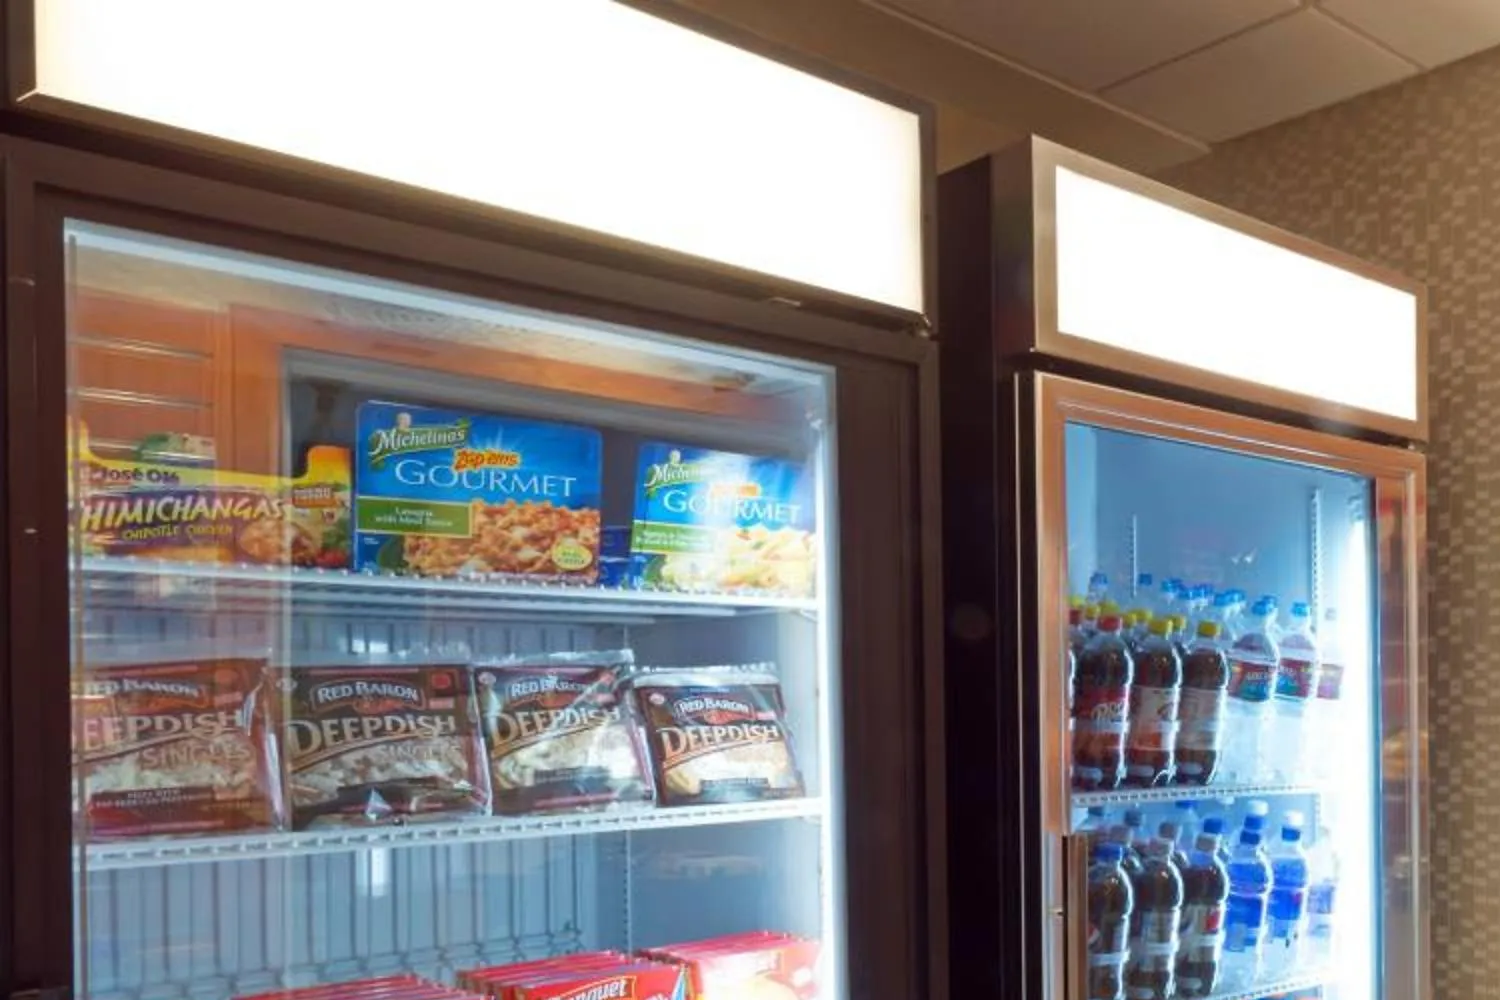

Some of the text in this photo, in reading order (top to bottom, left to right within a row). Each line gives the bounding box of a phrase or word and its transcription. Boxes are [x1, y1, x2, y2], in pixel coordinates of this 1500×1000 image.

[395, 458, 577, 497] GOURMET
[79, 494, 285, 530] HIMICHANGAS
[317, 681, 419, 703] RED BARON
[83, 711, 254, 751] EEPDISH
[287, 714, 457, 758] DEEPDISH
[656, 724, 780, 758] DEEPDISH
